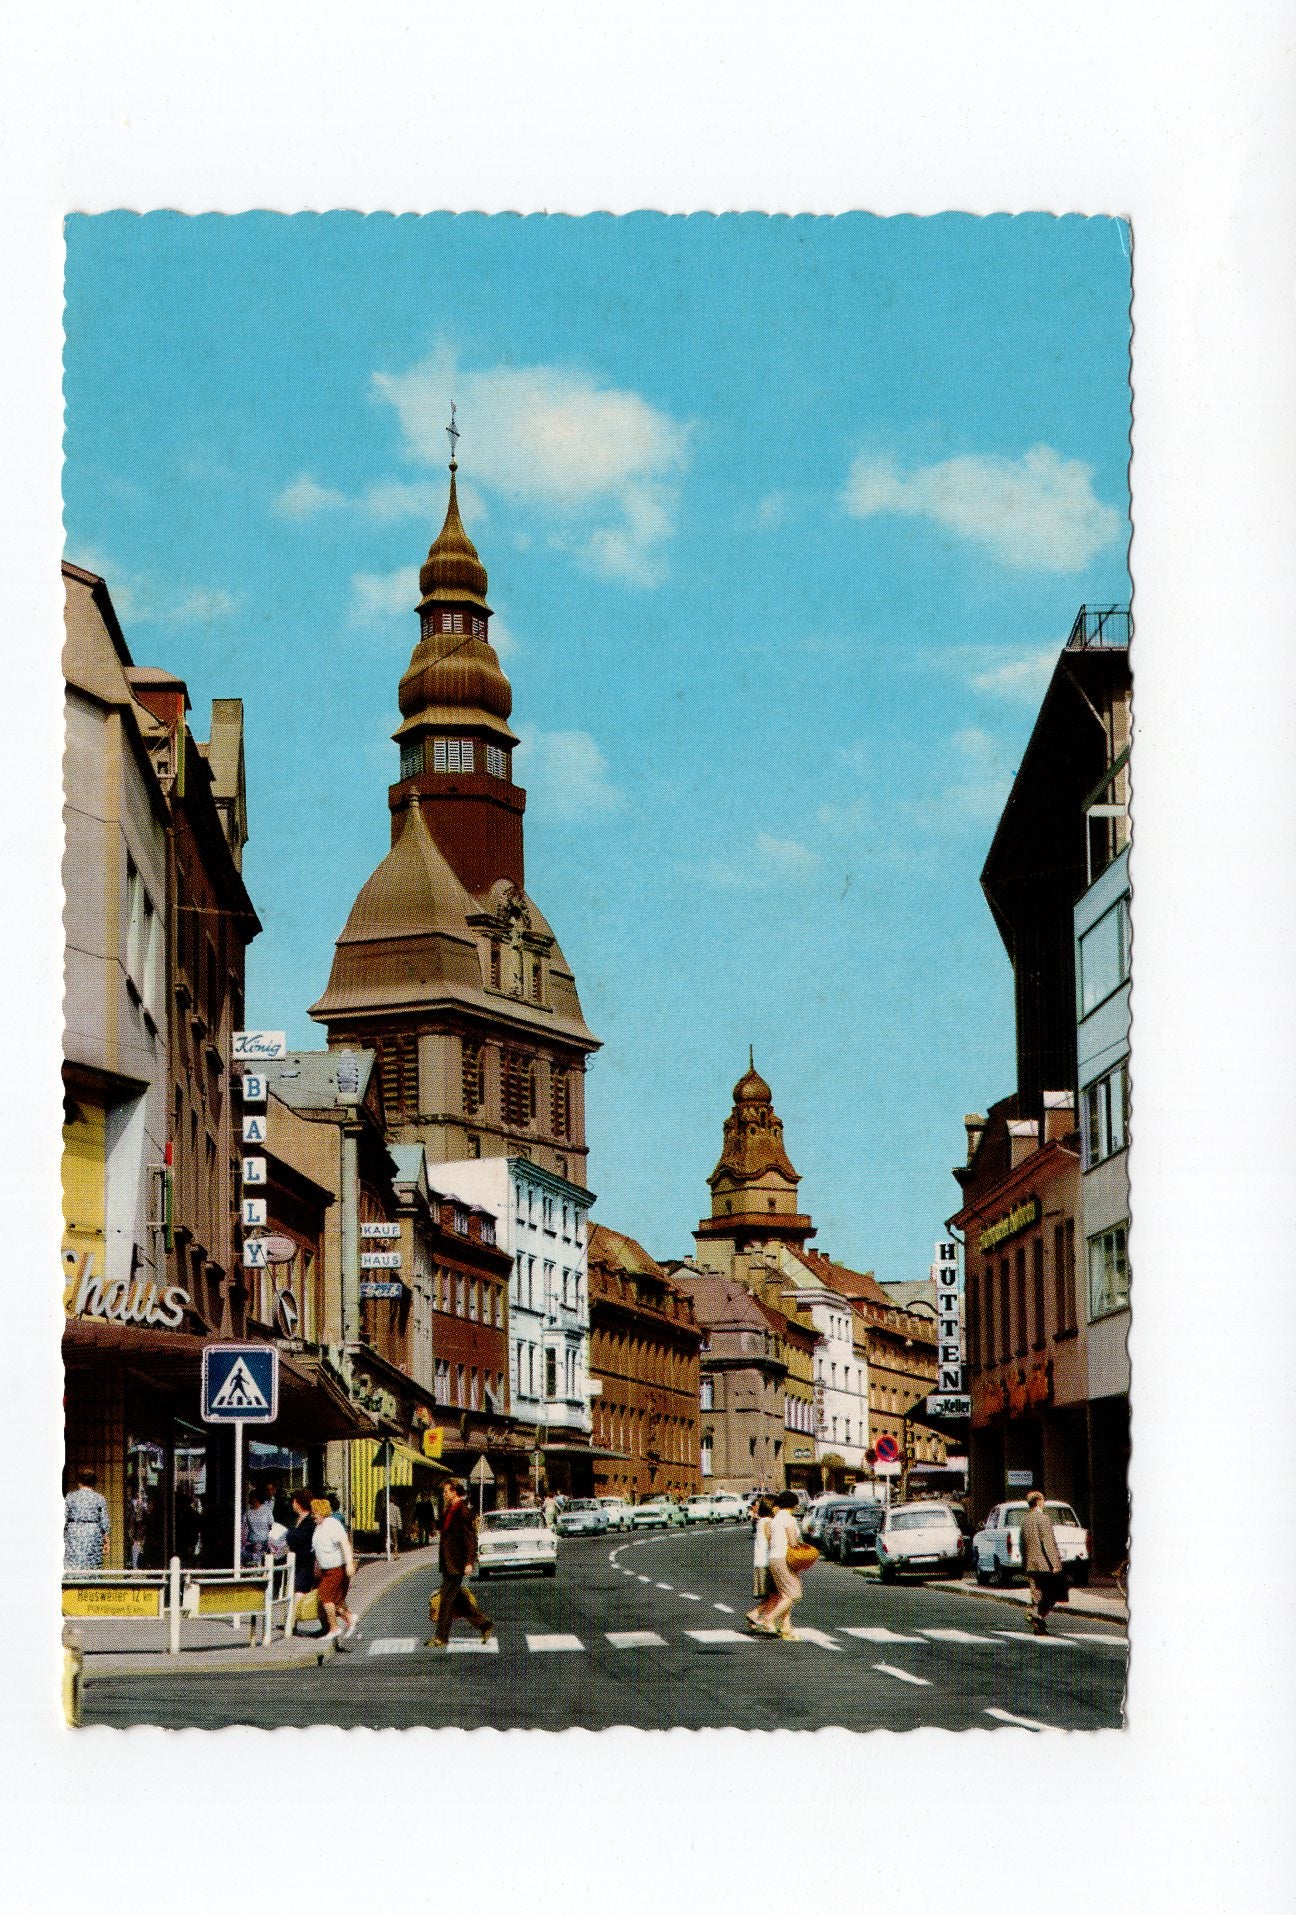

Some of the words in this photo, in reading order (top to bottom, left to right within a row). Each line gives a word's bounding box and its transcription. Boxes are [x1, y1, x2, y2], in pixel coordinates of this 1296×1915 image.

[235, 1034, 282, 1058] König
[246, 1078, 263, 1263] BALLY
[364, 1226, 398, 1235] KAUF
[364, 1255, 399, 1265] HAUS
[939, 1243, 959, 1388] HÜTTEN
